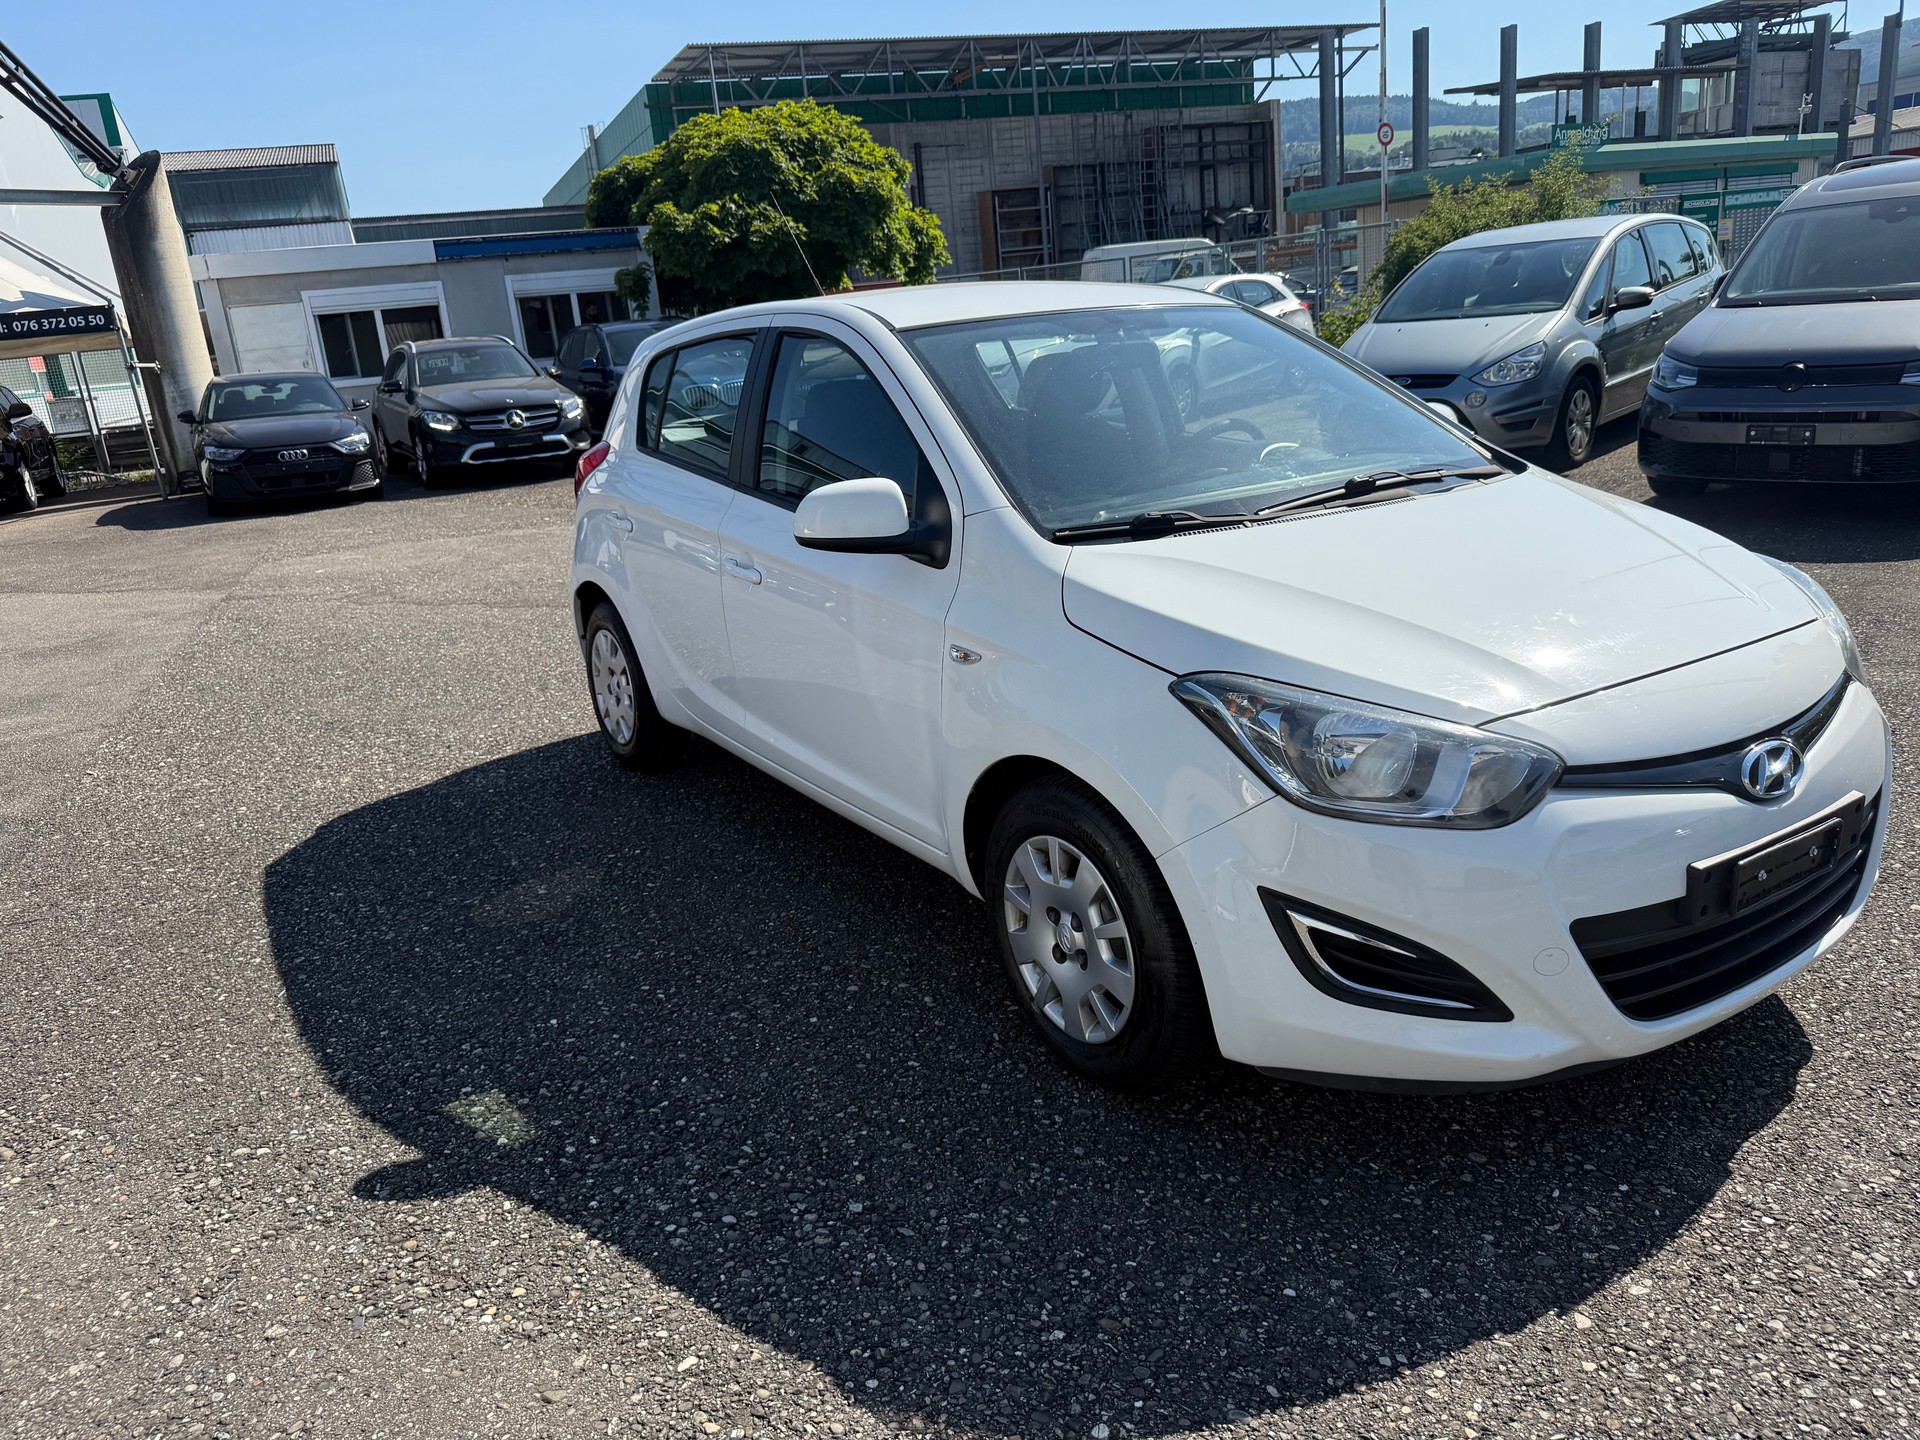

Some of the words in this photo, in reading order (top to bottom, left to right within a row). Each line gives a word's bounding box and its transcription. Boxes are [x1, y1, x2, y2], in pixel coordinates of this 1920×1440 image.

[13, 320, 39, 332] 076
[41, 317, 67, 330] 372
[68, 315, 86, 328] 05
[88, 314, 105, 326] 50
